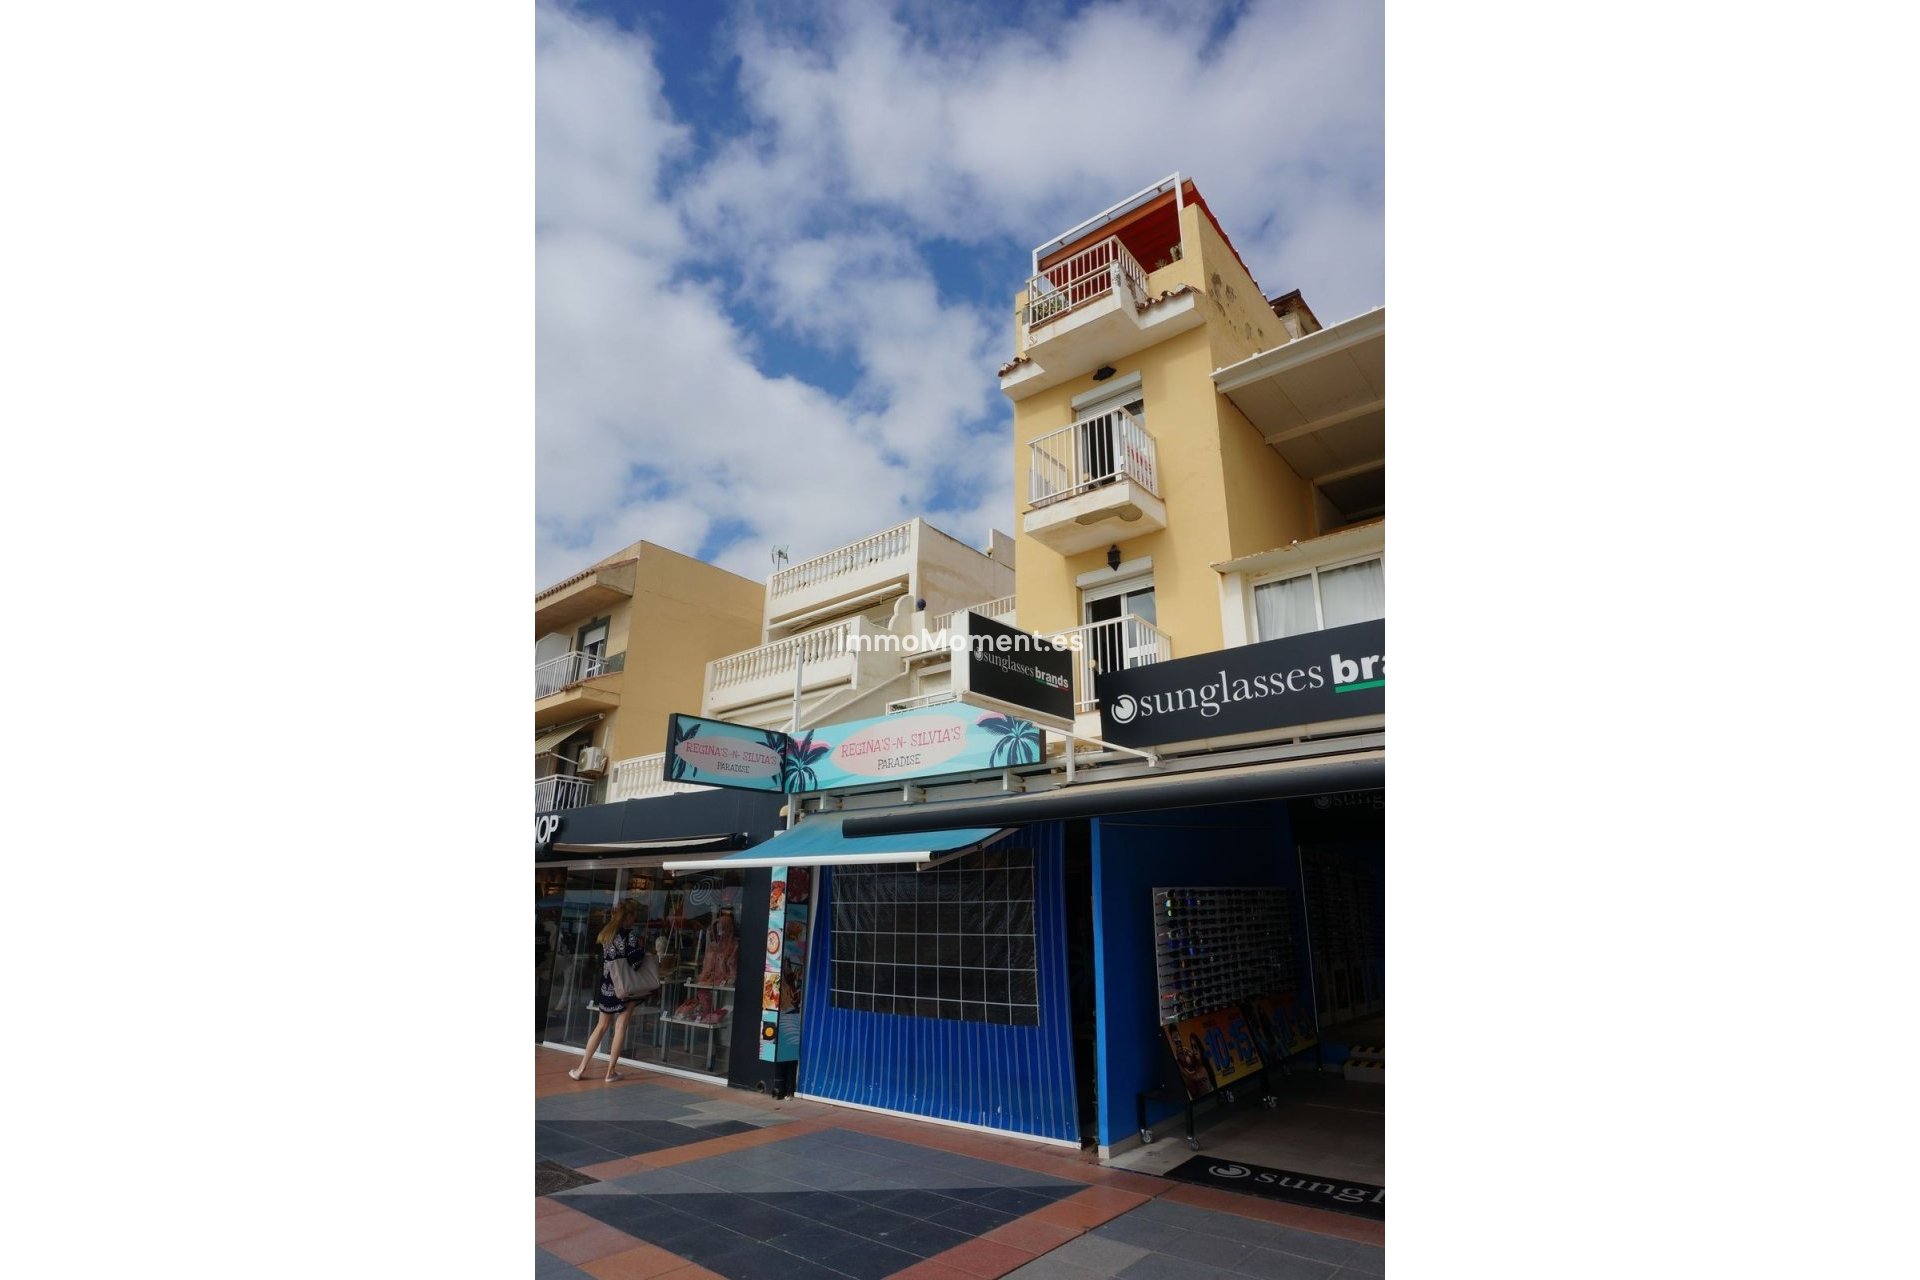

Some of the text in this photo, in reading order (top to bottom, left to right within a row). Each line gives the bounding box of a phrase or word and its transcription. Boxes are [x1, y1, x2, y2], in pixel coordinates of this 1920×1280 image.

[983, 650, 1069, 688] sunglasses brands
[1141, 664, 1325, 718] sunglasses
[685, 741, 728, 758] REGINA'S
[742, 750, 777, 766] SILVIA'S
[841, 737, 892, 758] REGINA'S
[910, 726, 961, 748] SILVIA'S
[717, 761, 751, 774] PARADISE
[878, 754, 921, 770] PARADISE
